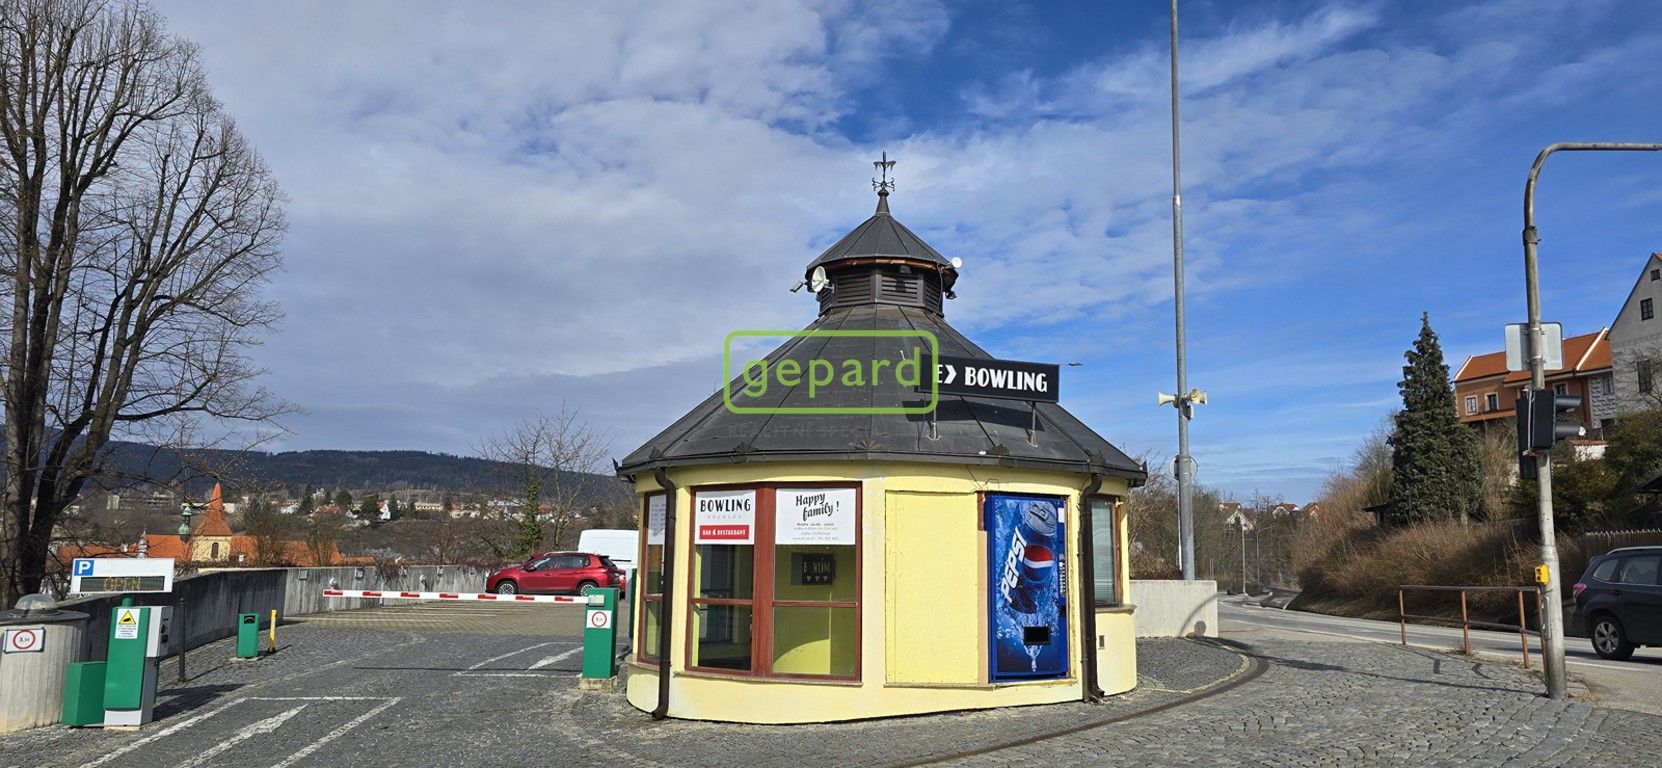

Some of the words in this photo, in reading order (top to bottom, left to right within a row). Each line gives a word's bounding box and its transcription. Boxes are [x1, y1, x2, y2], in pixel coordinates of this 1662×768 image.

[965, 366, 1048, 393] BOWLING
[700, 498, 751, 512] BOWLING
[795, 493, 826, 507] Happy
[78, 561, 91, 575] P
[1000, 525, 1027, 604] PEPSI
